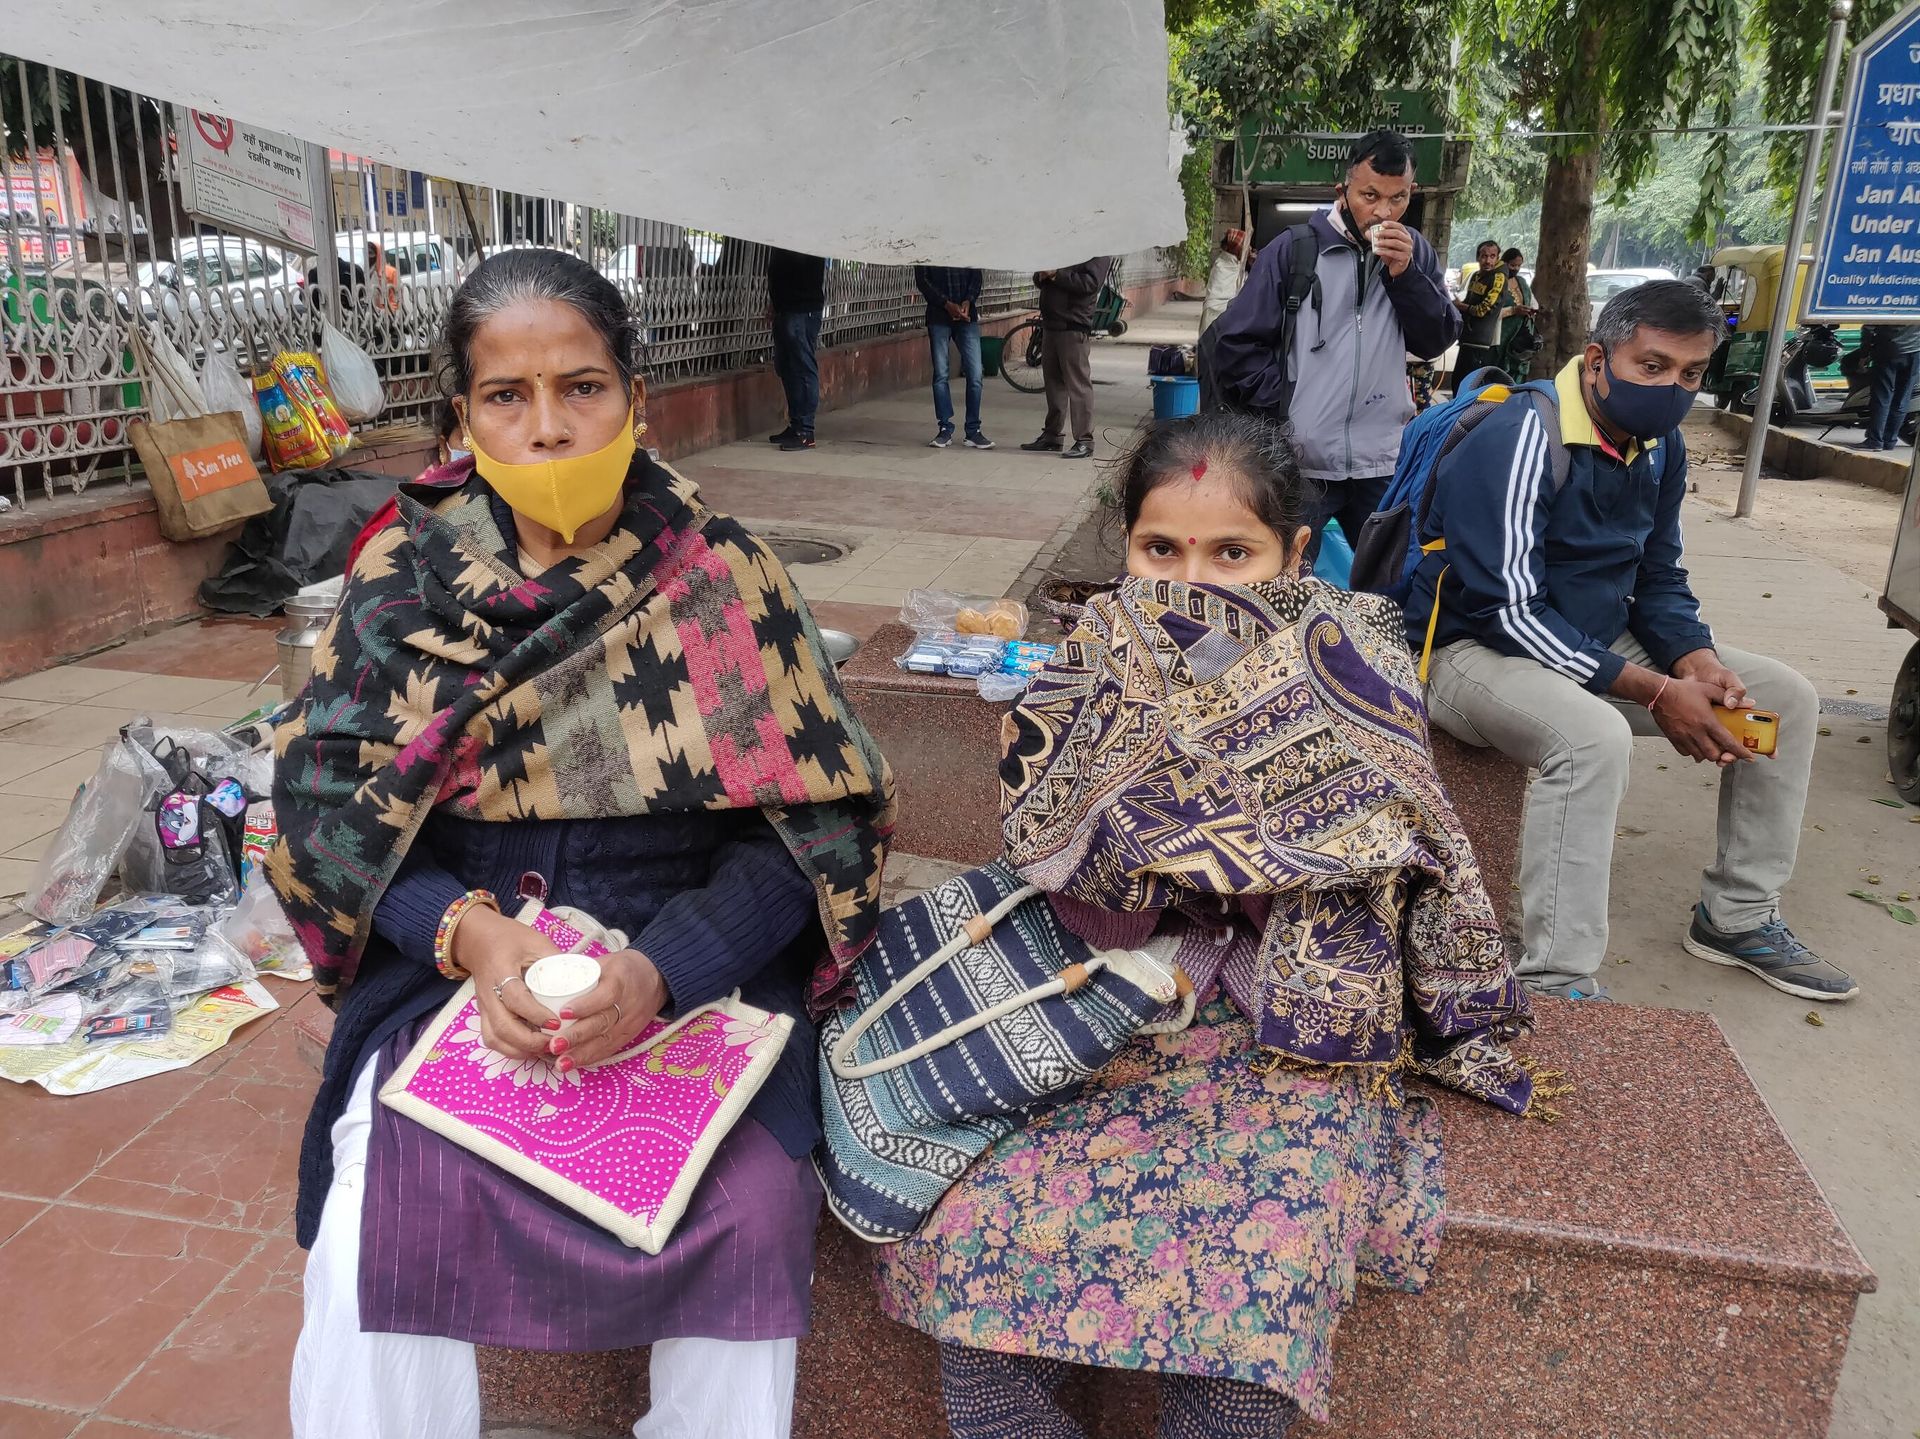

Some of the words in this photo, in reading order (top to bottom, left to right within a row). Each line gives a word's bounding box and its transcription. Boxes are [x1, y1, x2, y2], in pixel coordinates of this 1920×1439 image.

[1877, 84, 1920, 106] प्रधा
[1307, 144, 1352, 160] SUBW
[1855, 184, 1896, 204] Jan
[1850, 214, 1914, 234] Under
[1843, 243, 1882, 263] Jan
[1827, 274, 1866, 287] Quality
[1846, 294, 1879, 305] New
[1881, 294, 1917, 305] Delhi
[217, 453, 244, 470] Tree
